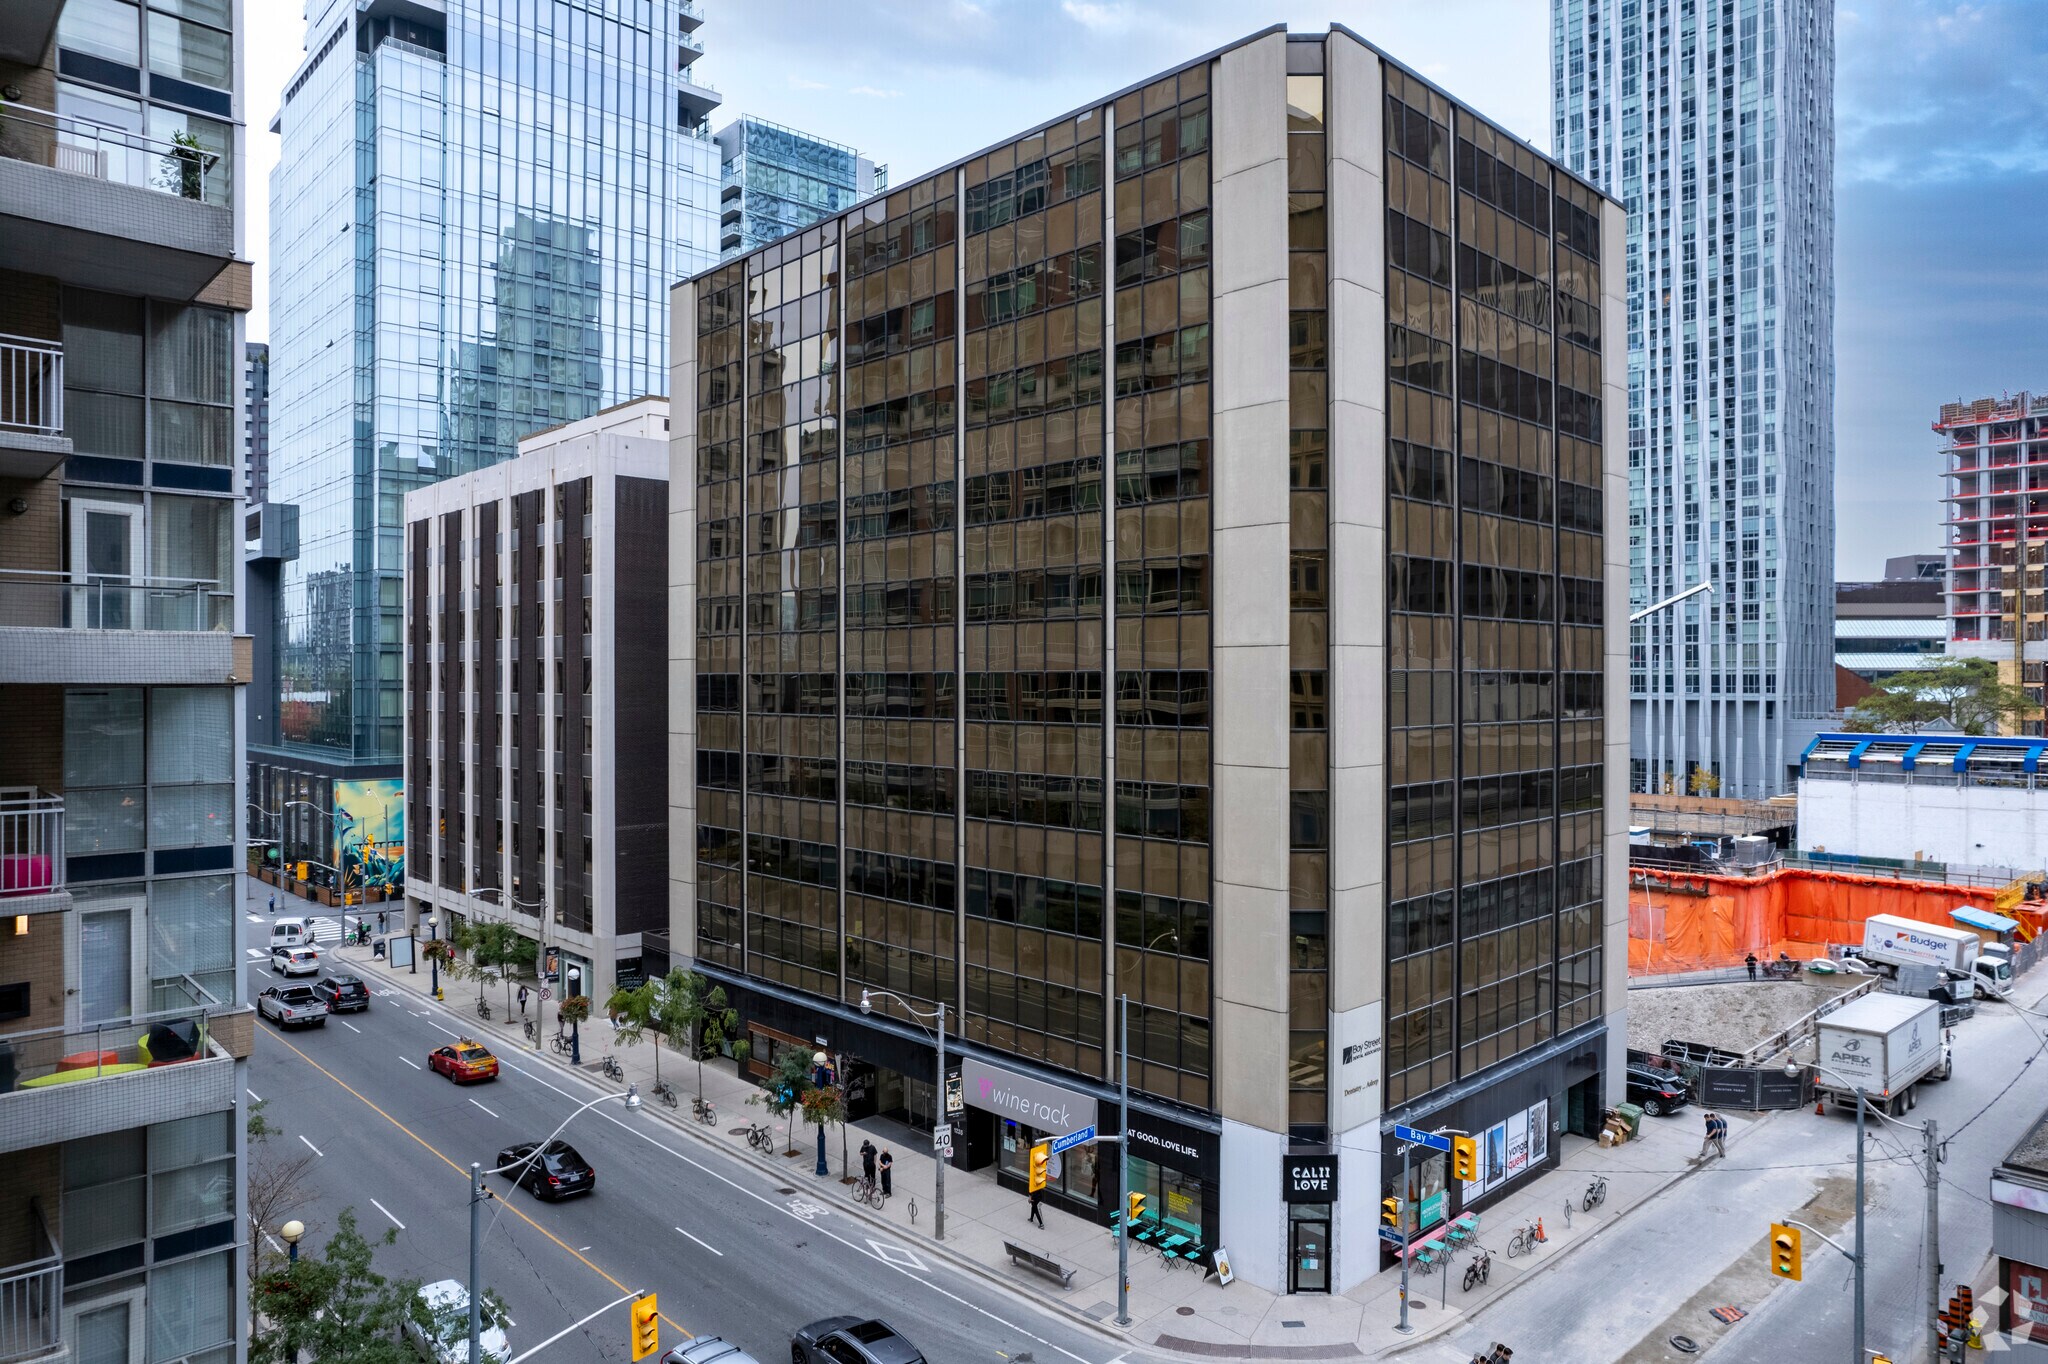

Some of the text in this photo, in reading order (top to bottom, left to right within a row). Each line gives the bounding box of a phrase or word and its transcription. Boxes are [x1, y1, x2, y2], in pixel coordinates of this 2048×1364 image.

[1910, 935, 1948, 950] Budget
[1352, 1037, 1381, 1054] Bay Street
[1908, 1038, 1922, 1053] APEX
[1831, 1052, 1871, 1064] APEX
[993, 1088, 1070, 1127] wine rack
[936, 1134, 950, 1147] 40
[1053, 1130, 1089, 1150] Cumberland
[1126, 1128, 1199, 1158] AT GOOD. LOVE LIFE.
[1410, 1130, 1426, 1143] Bay
[1508, 1141, 1528, 1160] yonge
[1508, 1152, 1528, 1171] queen
[1292, 1167, 1330, 1178] CALII
[1294, 1179, 1328, 1190] LOVE
